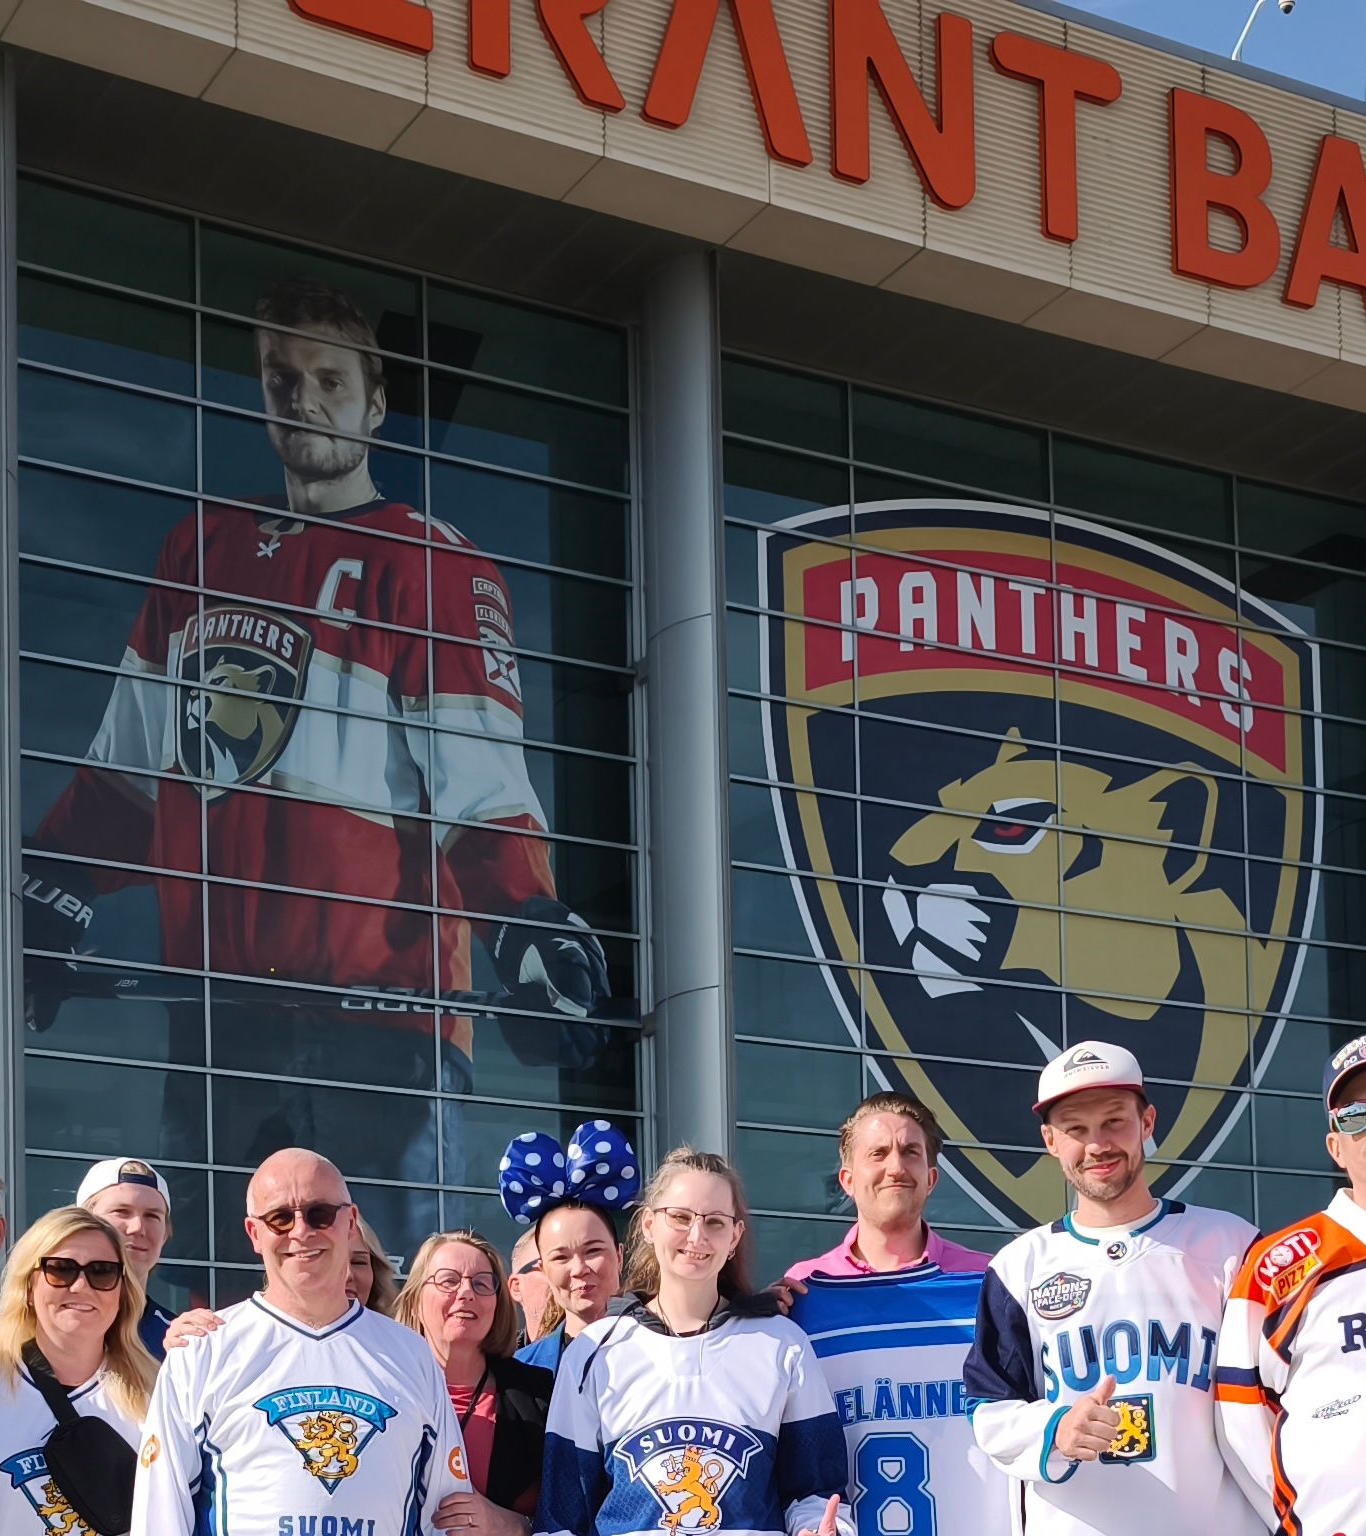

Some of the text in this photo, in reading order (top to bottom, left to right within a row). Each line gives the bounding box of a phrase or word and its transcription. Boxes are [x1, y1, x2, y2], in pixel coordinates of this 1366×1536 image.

[839, 571, 1255, 734] PANTHERS
[1040, 1319, 1217, 1404] SUOMI
[271, 1390, 378, 1417] FINLAND
[638, 1423, 737, 1454] SUOMI
